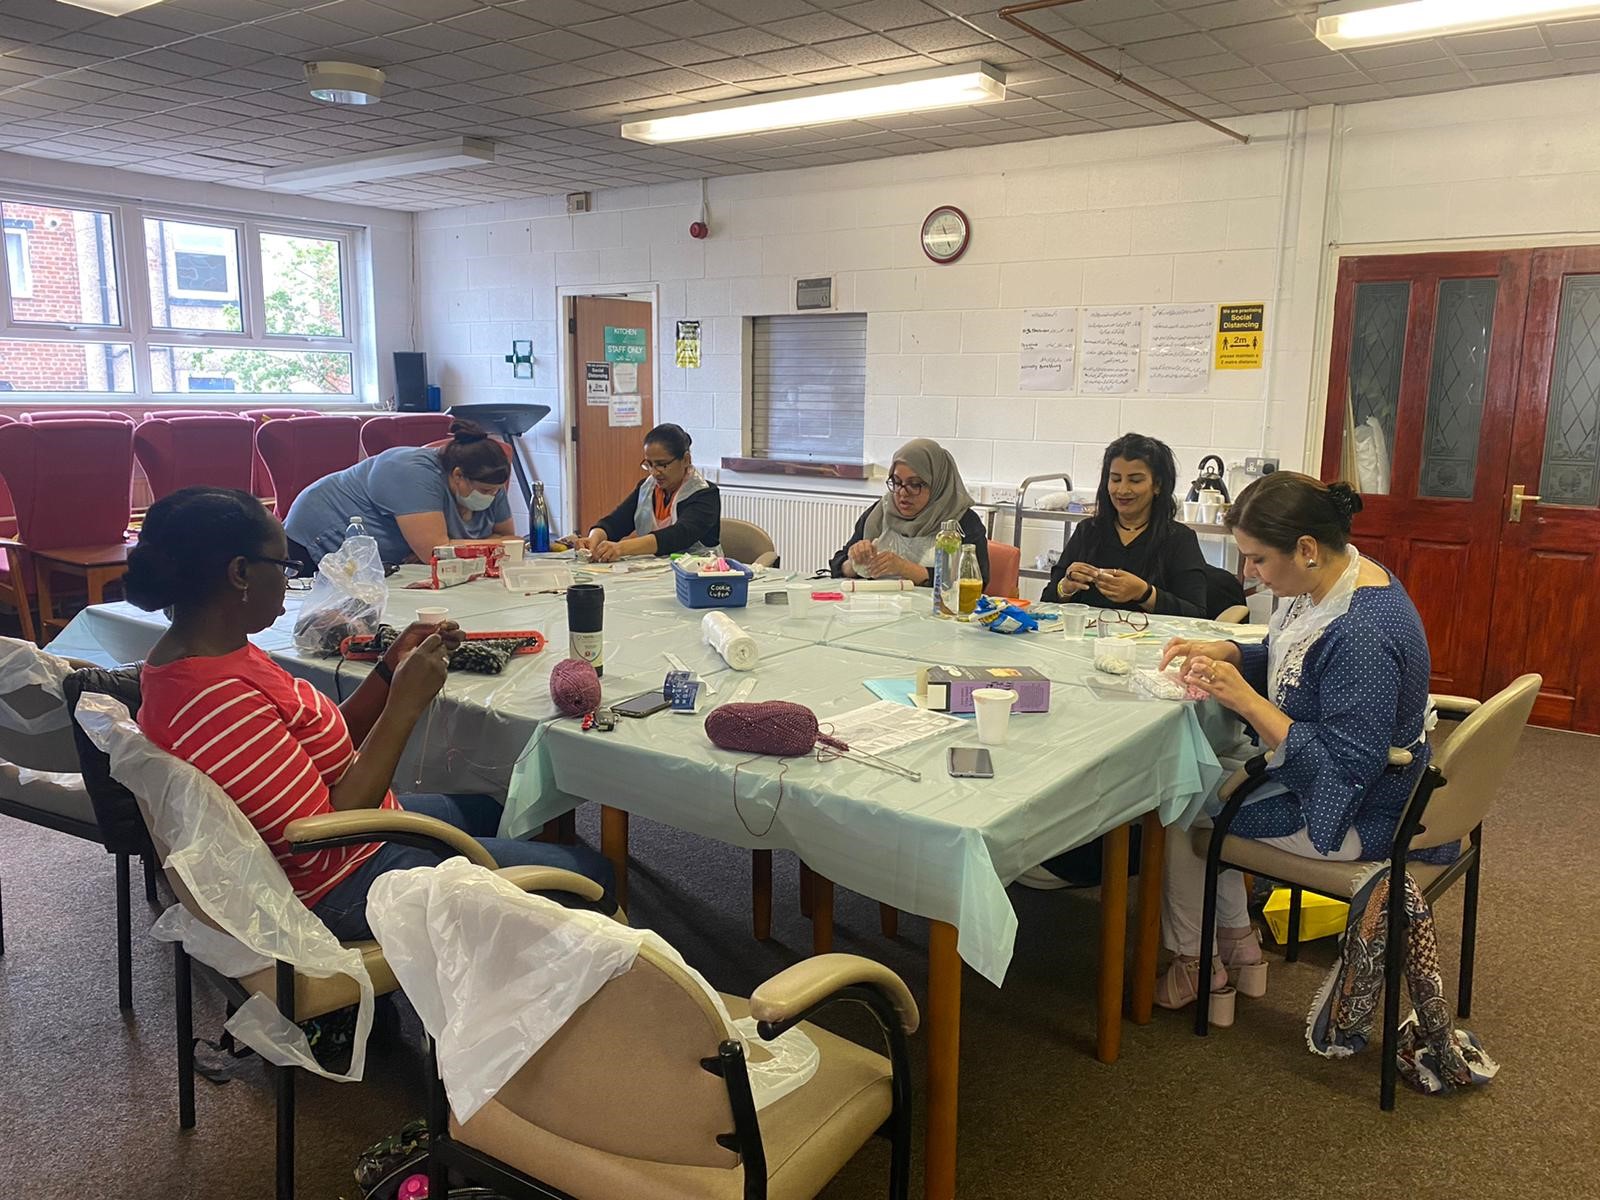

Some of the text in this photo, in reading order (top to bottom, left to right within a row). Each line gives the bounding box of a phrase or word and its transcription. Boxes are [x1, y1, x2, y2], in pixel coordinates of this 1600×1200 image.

[614, 328, 637, 336] KITCHEN
[1233, 336, 1247, 344] 2m
[607, 345, 643, 354] STAFF ONLY
